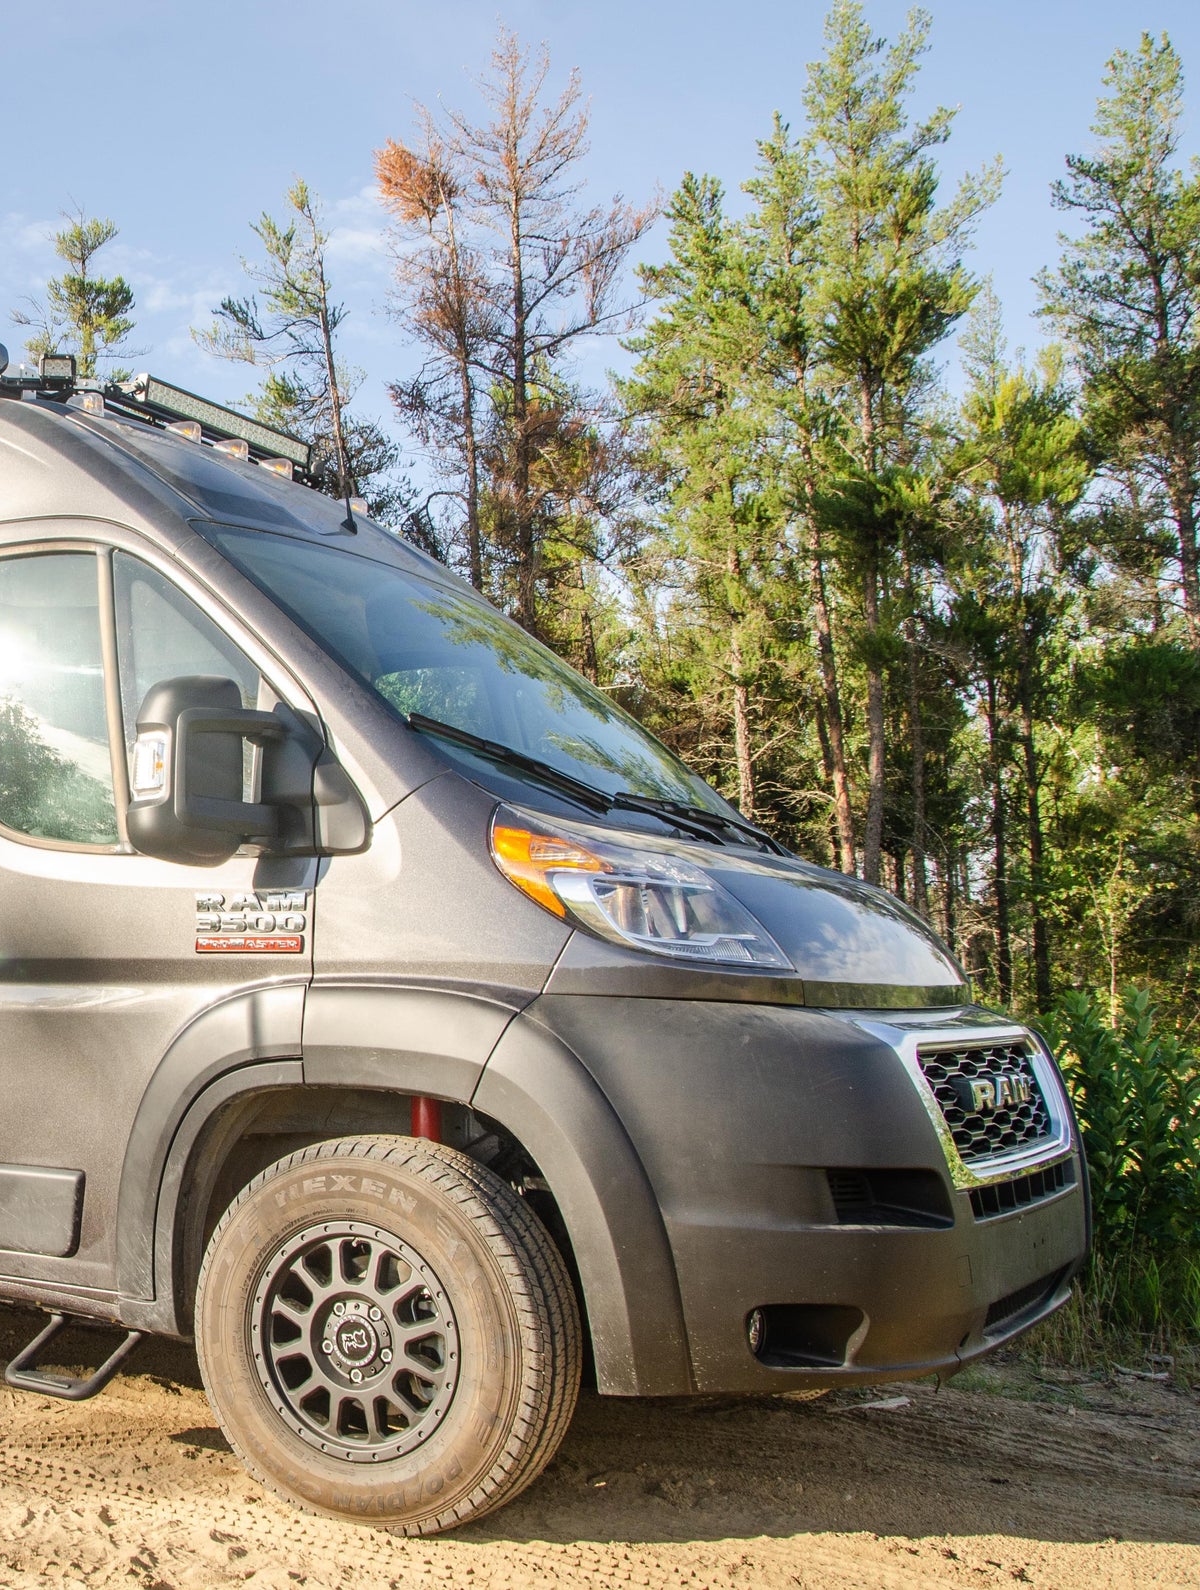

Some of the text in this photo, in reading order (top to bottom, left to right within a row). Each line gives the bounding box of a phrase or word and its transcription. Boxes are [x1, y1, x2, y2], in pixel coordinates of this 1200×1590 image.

[196, 892, 307, 912] RAM
[196, 913, 306, 933] 3500
[198, 938, 298, 948] PROMASTER
[970, 1073, 1032, 1111] RAM
[274, 1174, 418, 1214] NEXEN
